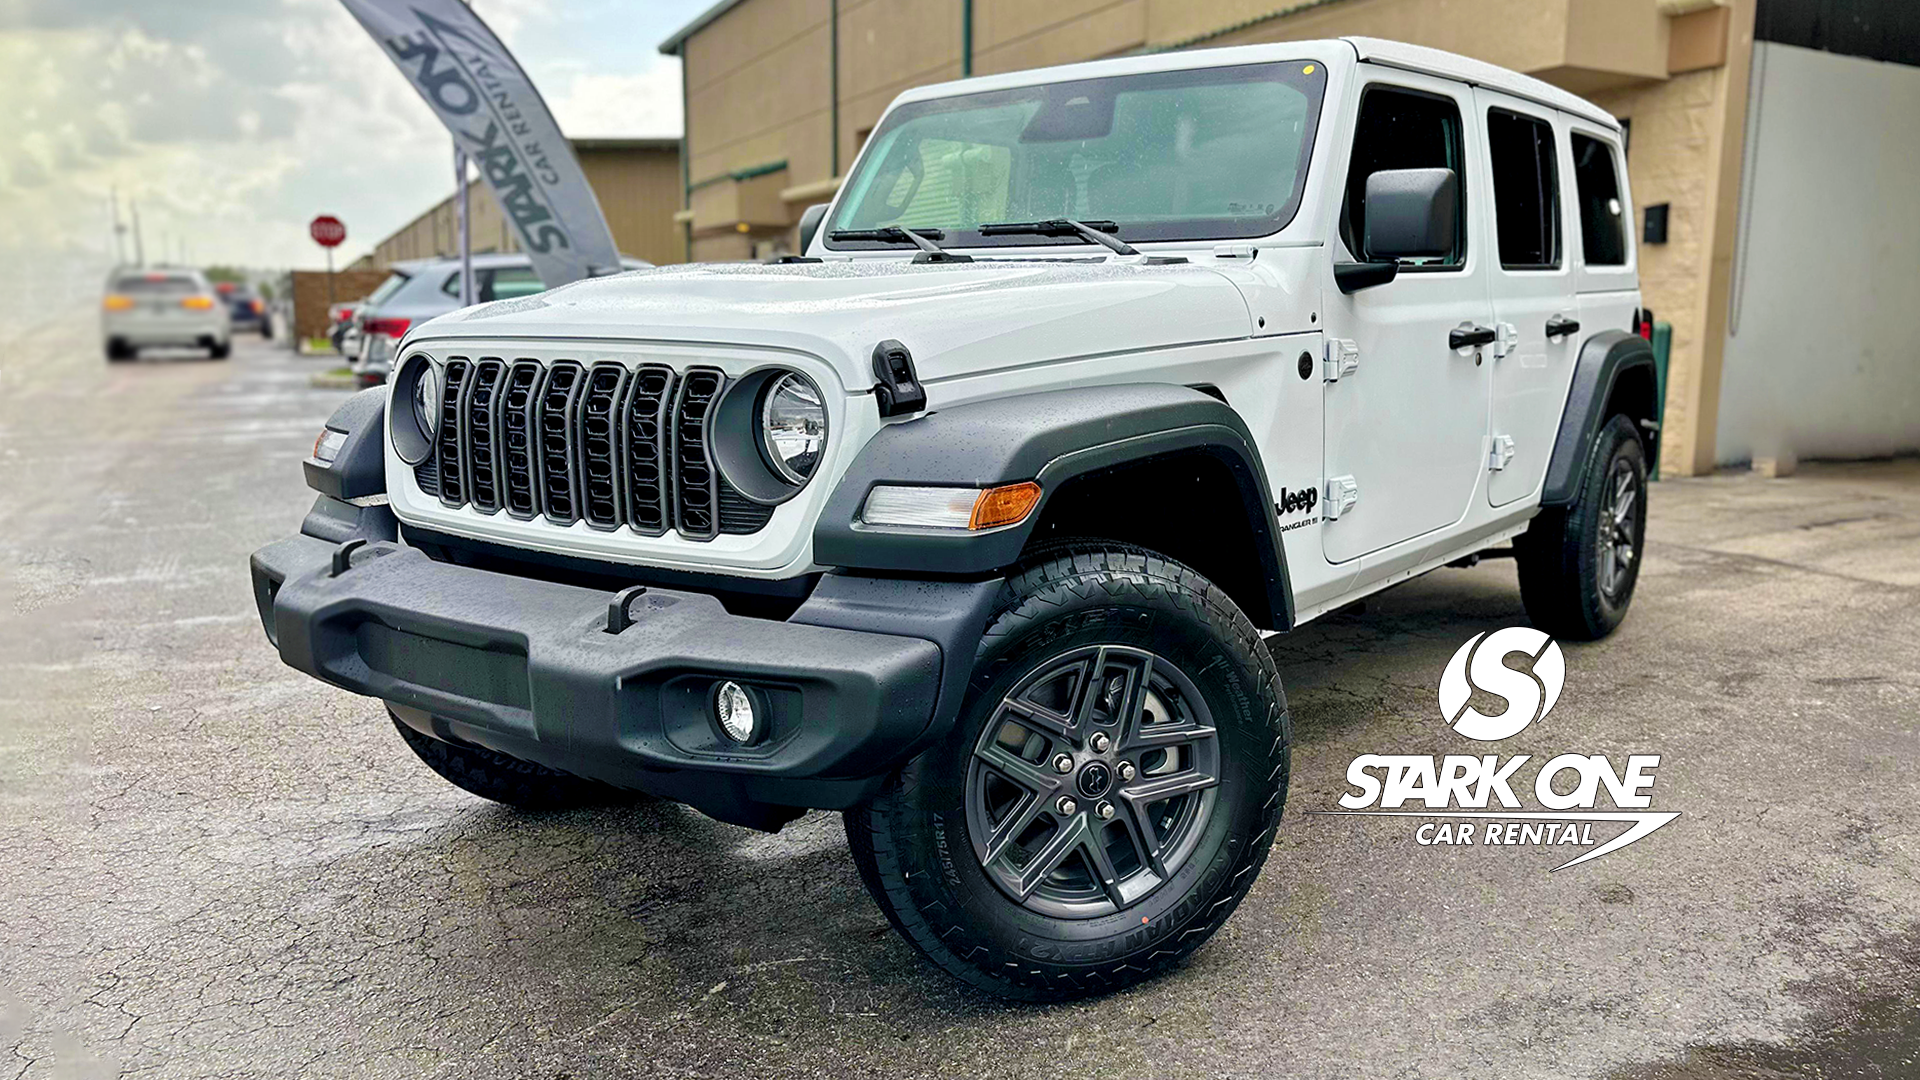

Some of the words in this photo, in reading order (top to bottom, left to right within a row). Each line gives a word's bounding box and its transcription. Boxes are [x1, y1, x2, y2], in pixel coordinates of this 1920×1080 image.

[386, 29, 479, 116] ONE
[461, 119, 569, 254] STARK
[524, 138, 560, 186] CAR
[1275, 486, 1318, 516] Jeep
[1280, 518, 1311, 532] RANGLER
[1209, 653, 1253, 723] All-Weather
[933, 812, 961, 886] 245/75R17
